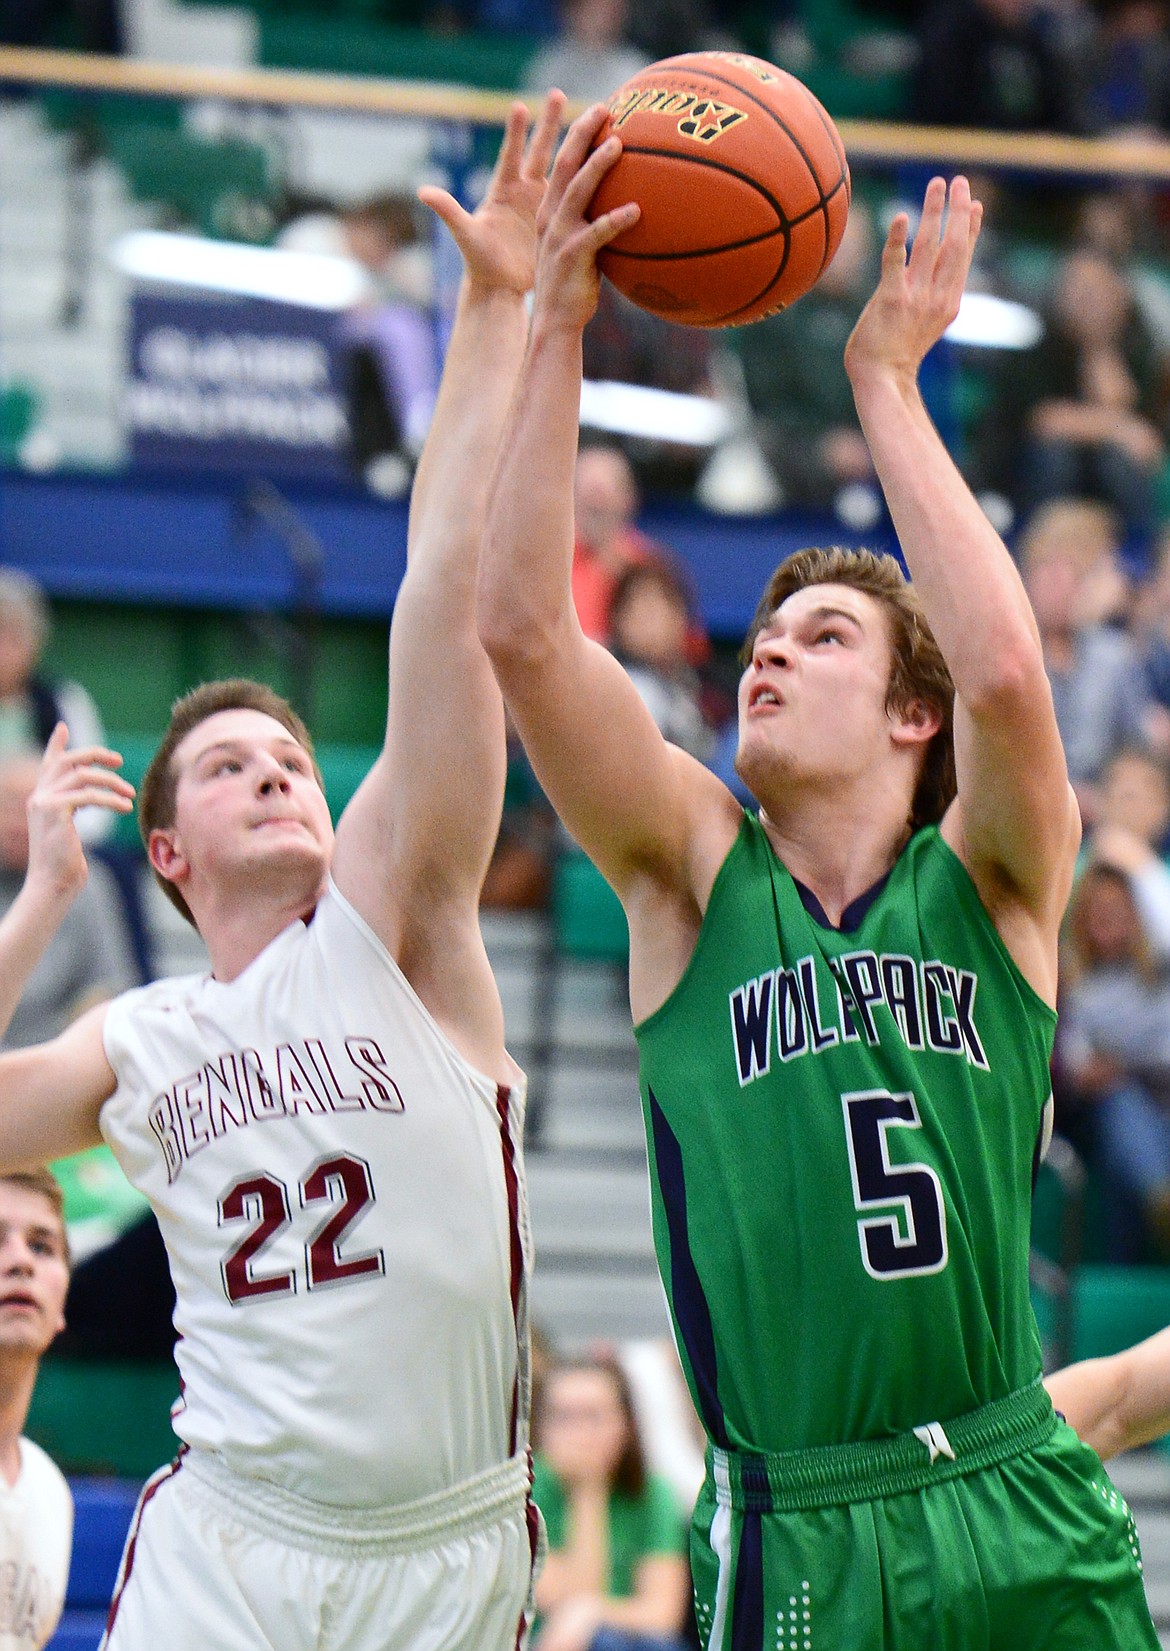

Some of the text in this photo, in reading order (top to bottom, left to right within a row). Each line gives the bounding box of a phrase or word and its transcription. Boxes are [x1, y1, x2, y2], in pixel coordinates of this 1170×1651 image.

[728, 949, 991, 1088] WOLFPACK
[147, 1036, 405, 1187] BENGALS
[840, 1088, 948, 1281] 5
[216, 1150, 386, 1307] 22
